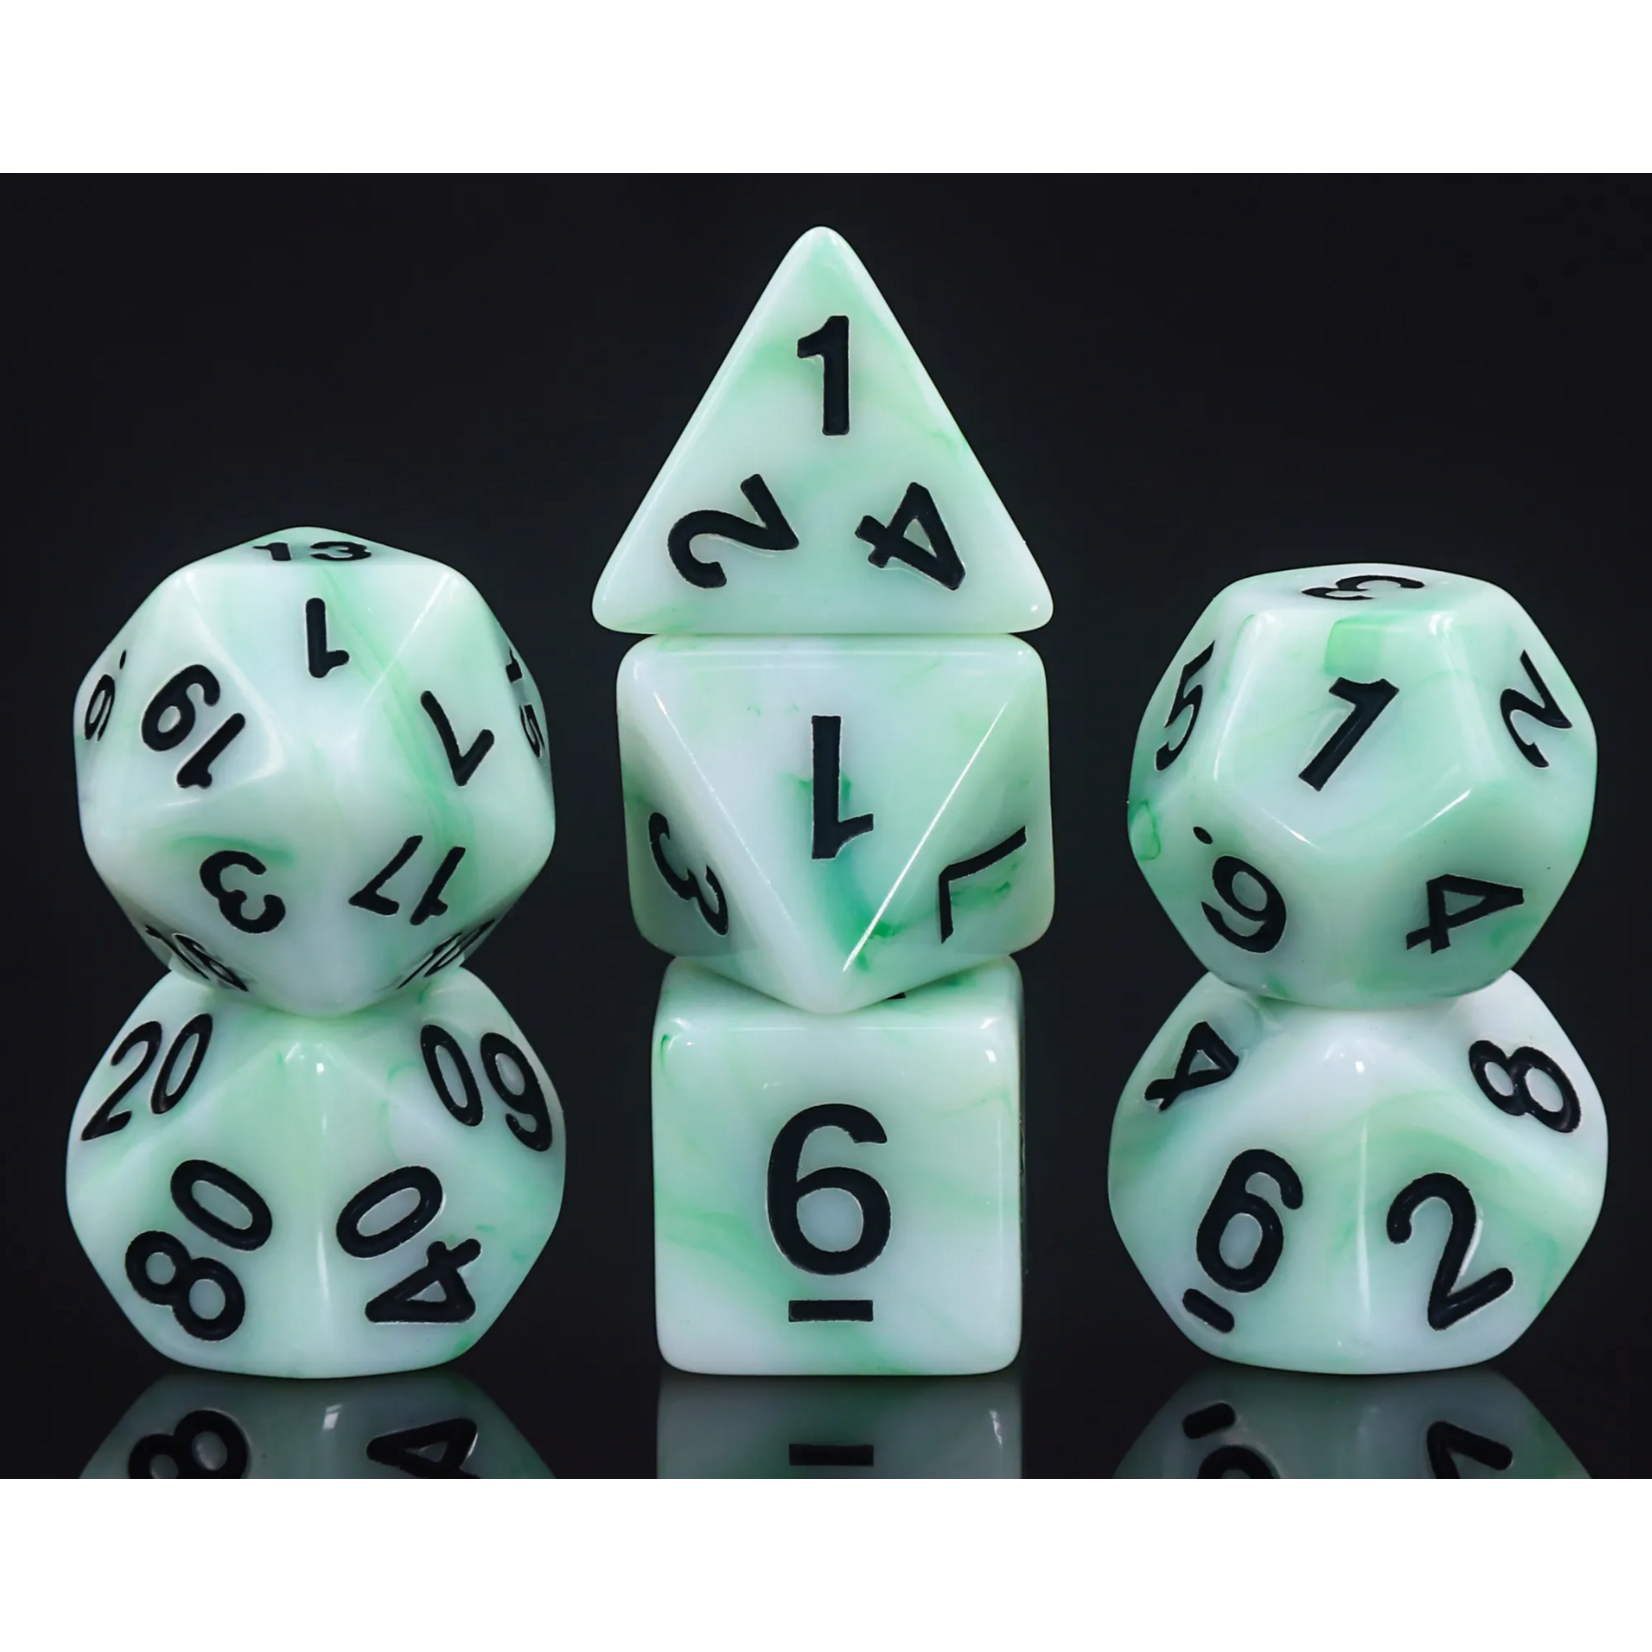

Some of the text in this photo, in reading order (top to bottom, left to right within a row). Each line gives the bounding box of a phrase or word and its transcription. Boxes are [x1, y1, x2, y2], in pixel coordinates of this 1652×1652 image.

[797, 316, 849, 435] 1
[254, 541, 372, 562] 13
[668, 474, 799, 588] 2
[855, 482, 965, 590] 4
[1302, 574, 1425, 601] 3
[306, 598, 349, 678] 1
[142, 665, 246, 789] 19
[421, 691, 494, 786] 7
[1155, 641, 1215, 771] 5
[1299, 677, 1400, 792] 1
[1500, 650, 1573, 768] 2
[812, 716, 874, 860] 1
[199, 850, 287, 935] 3
[349, 835, 466, 926] 17
[648, 810, 730, 936] 3
[938, 825, 1027, 944] 7
[1406, 873, 1525, 954] 4
[81, 1013, 213, 1142] 20
[1144, 1021, 1240, 1113] 4
[1469, 1040, 1581, 1134] 8
[125, 1160, 273, 1342] 80
[336, 1166, 482, 1323] 40
[767, 1104, 892, 1323] 6
[1386, 1173, 1514, 1331] 2
